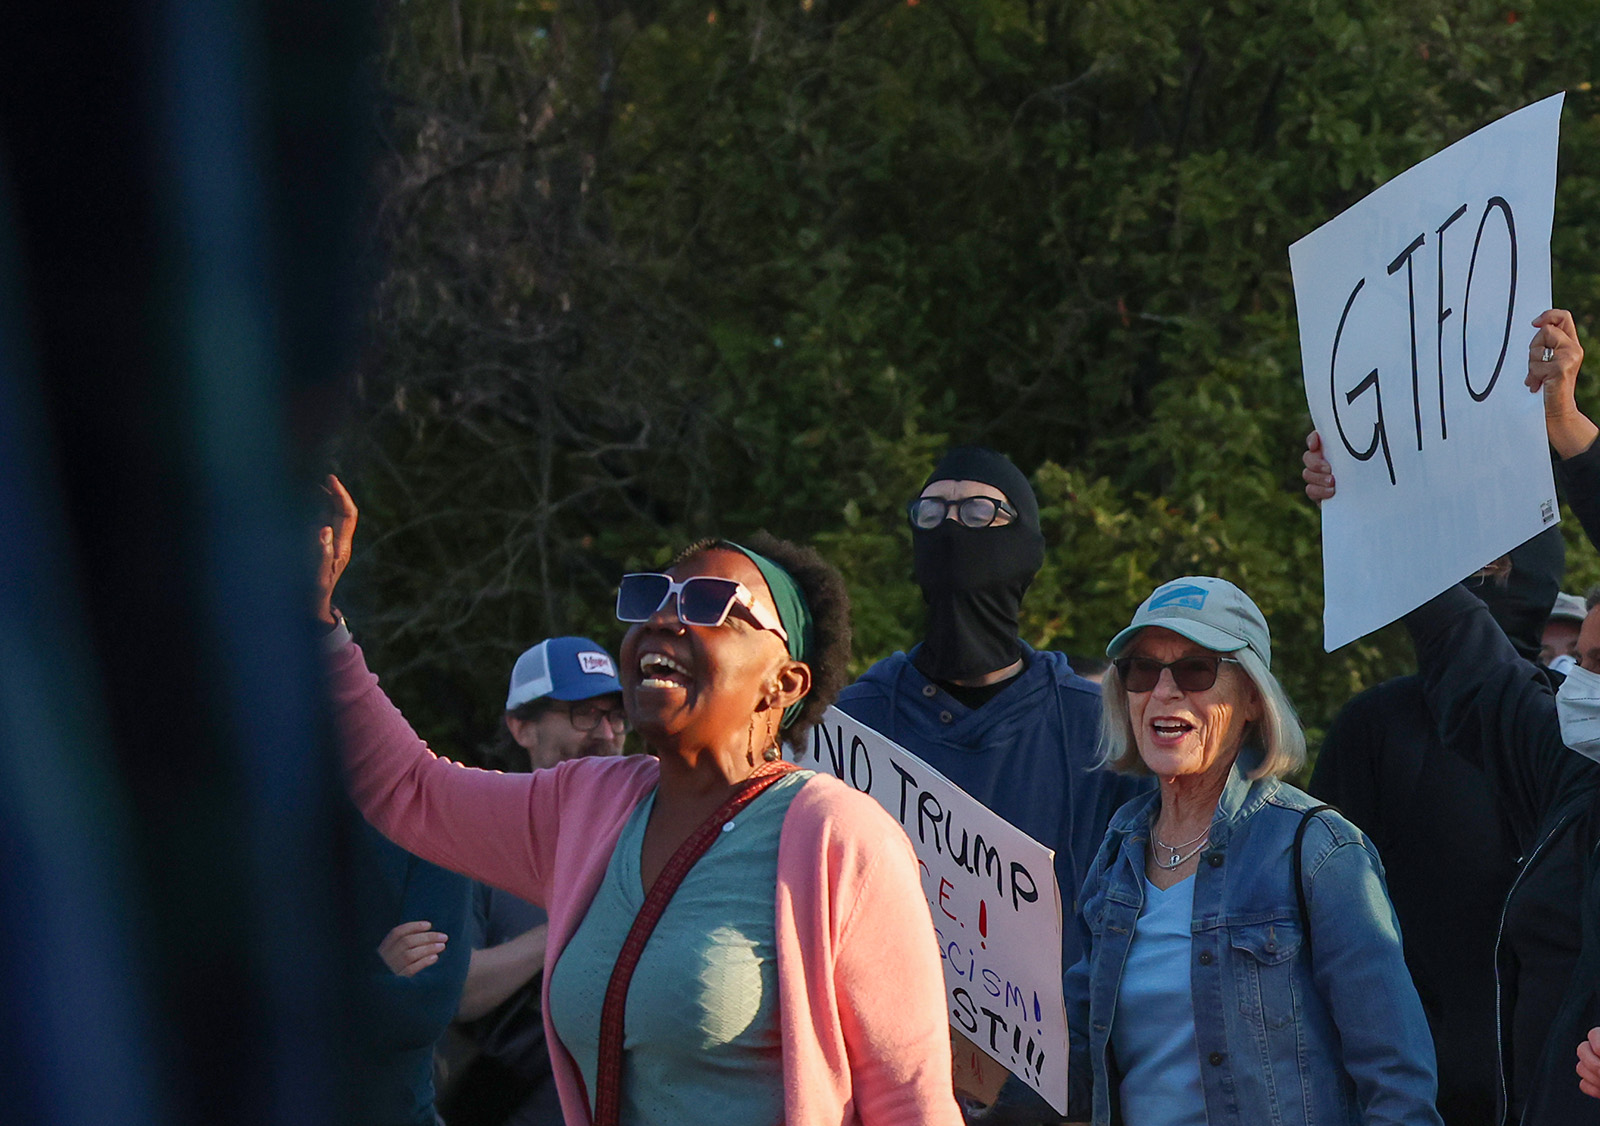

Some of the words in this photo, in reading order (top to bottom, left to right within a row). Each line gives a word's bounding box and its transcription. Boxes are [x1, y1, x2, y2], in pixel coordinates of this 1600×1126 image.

[1330, 195, 1517, 485] GTFO
[813, 722, 873, 794] NO
[889, 757, 1038, 911] TRUMP
